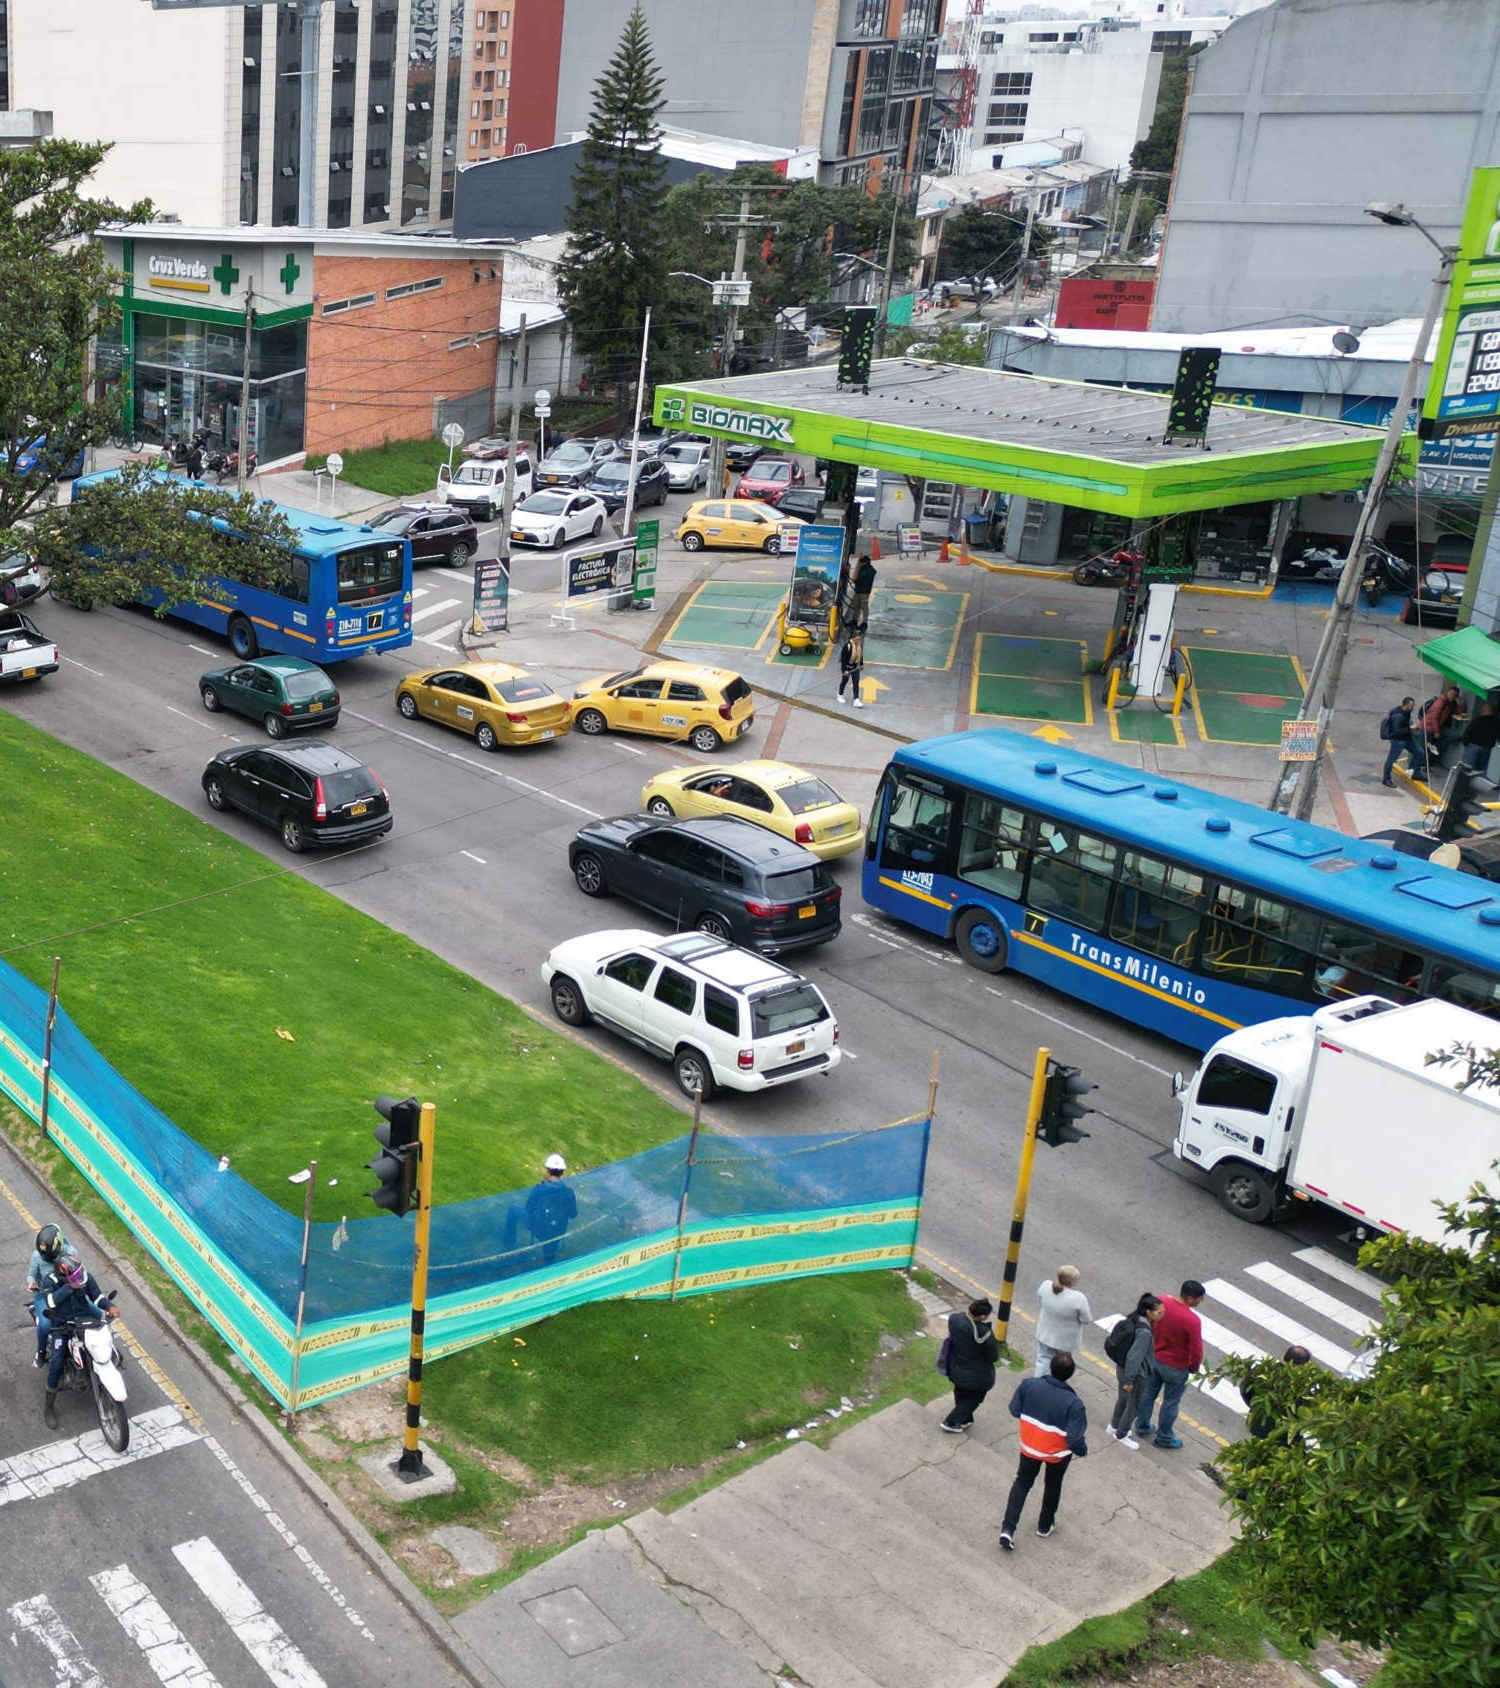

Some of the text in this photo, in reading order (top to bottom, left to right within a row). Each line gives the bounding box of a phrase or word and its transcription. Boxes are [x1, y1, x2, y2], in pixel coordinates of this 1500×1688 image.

[149, 255, 208, 279] CruzVerde
[1092, 293, 1145, 302] INSTITUTO
[691, 405, 787, 439] BIOMAX
[578, 559, 605, 571] FACTURA
[1071, 932, 1206, 1004] TransMilenio
